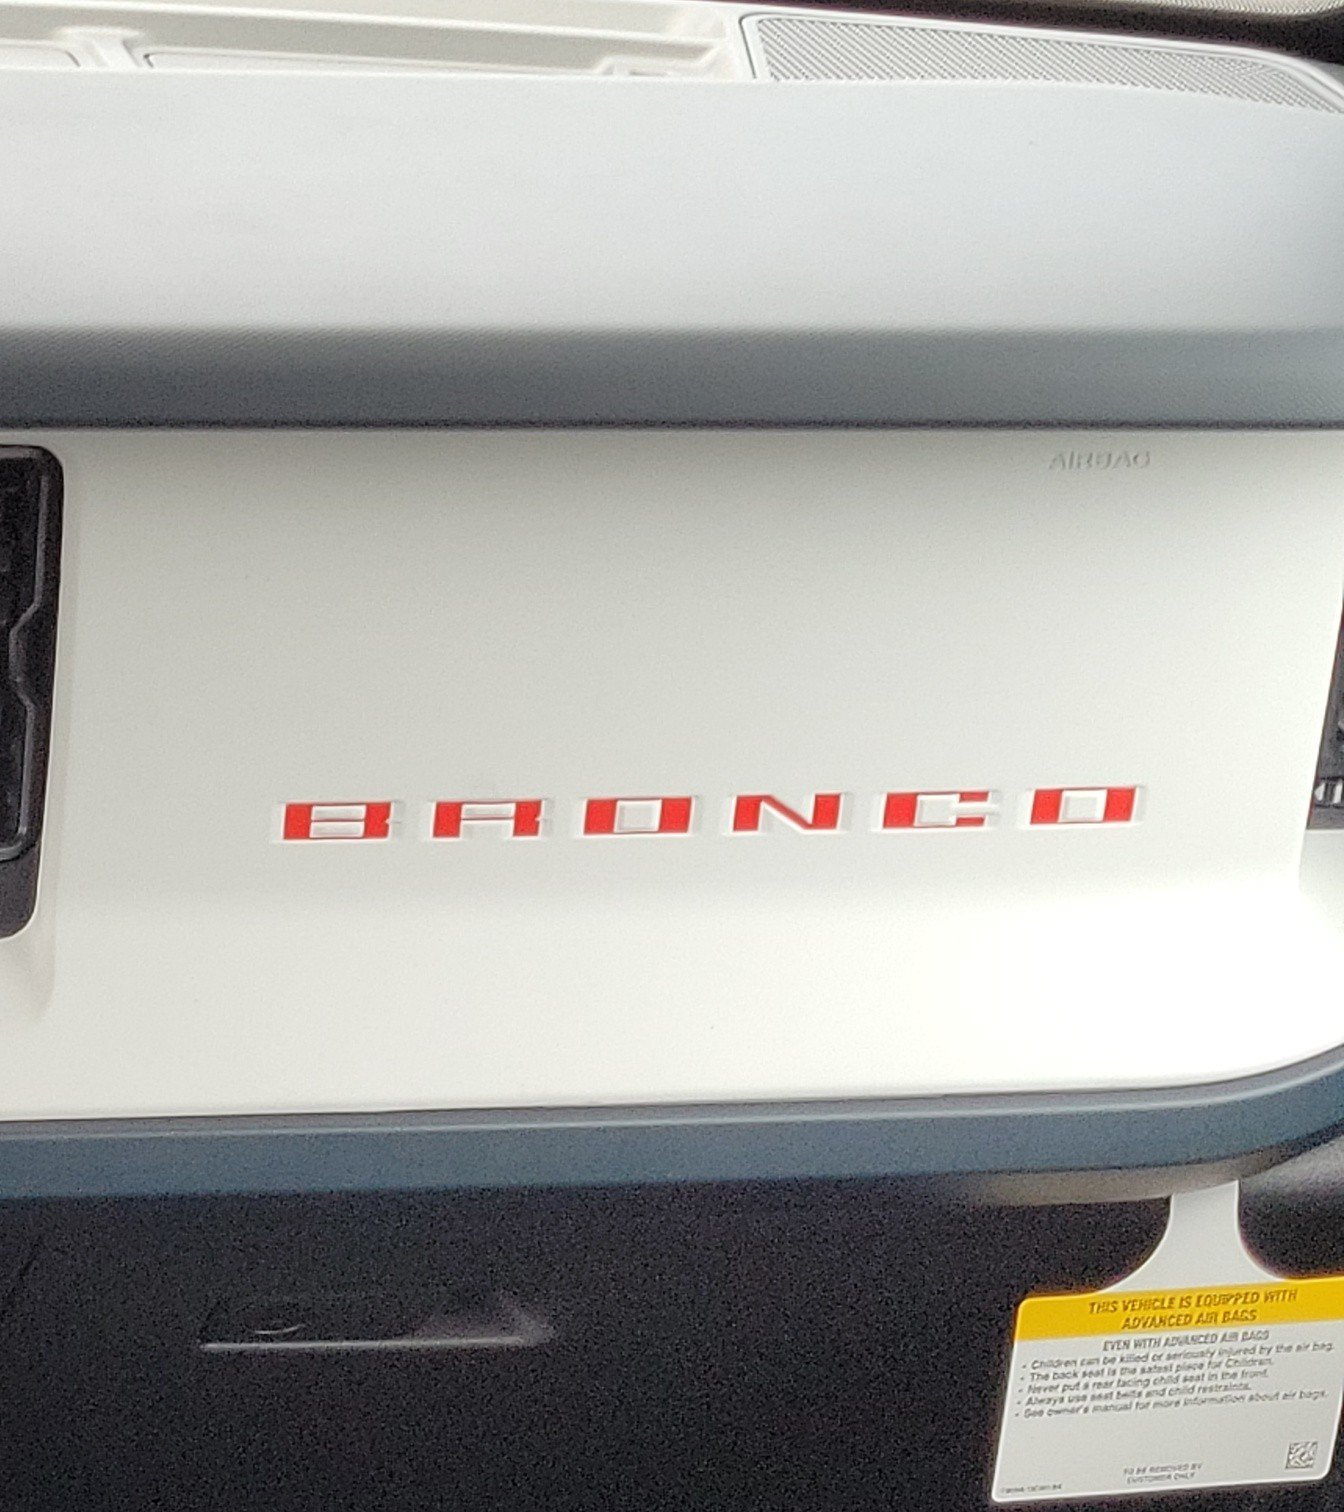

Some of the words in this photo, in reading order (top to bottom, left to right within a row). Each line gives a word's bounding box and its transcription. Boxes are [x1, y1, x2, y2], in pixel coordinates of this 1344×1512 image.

[278, 788, 1140, 840] BRONCO
[1089, 1300, 1117, 1314] THIS
[1122, 1297, 1175, 1312] VEHICLE
[1179, 1296, 1192, 1309] IS
[1195, 1291, 1260, 1309] EQUIPPED
[1264, 1289, 1297, 1303] WITH
[1121, 1314, 1192, 1330] ADVANCED
[1195, 1312, 1217, 1325] AIR
[1221, 1309, 1257, 1323] BAGS
[1102, 1339, 1130, 1351] EVEN
[1133, 1337, 1161, 1349] WITH
[1164, 1333, 1218, 1347] ADVANCED
[1220, 1331, 1239, 1342] AIR
[1241, 1330, 1270, 1341] BAGS
[1031, 1359, 1077, 1370] Children
[1080, 1358, 1100, 1366] can
[1102, 1356, 1116, 1365] be
[1120, 1354, 1150, 1363] killed
[1151, 1353, 1163, 1361] or
[1259, 1345, 1272, 1356] by
[1275, 1344, 1293, 1353] the
[1027, 1383, 1060, 1394] Never
[1062, 1381, 1080, 1393] put
[1092, 1380, 1114, 1389] rear
[1117, 1377, 1151, 1388] facing
[1153, 1374, 1180, 1385] child
[1182, 1372, 1205, 1382] seat
[1208, 1371, 1219, 1381] in
[1221, 1370, 1238, 1380] the
[1030, 1372, 1050, 1382] The
[1052, 1370, 1078, 1380] back
[1082, 1368, 1104, 1378] seat
[1107, 1367, 1116, 1376] is
[1120, 1366, 1137, 1376] the
[1140, 1362, 1173, 1374] safest
[1176, 1362, 1204, 1373] place
[1207, 1360, 1222, 1369] for
[1067, 1394, 1087, 1403] use
[1090, 1391, 1114, 1401] seat
[1115, 1389, 1142, 1400] belts
[1145, 1387, 1166, 1398] and
[1168, 1384, 1195, 1396] child
[1024, 1408, 1044, 1418] See
[1135, 1401, 1150, 1410] for
